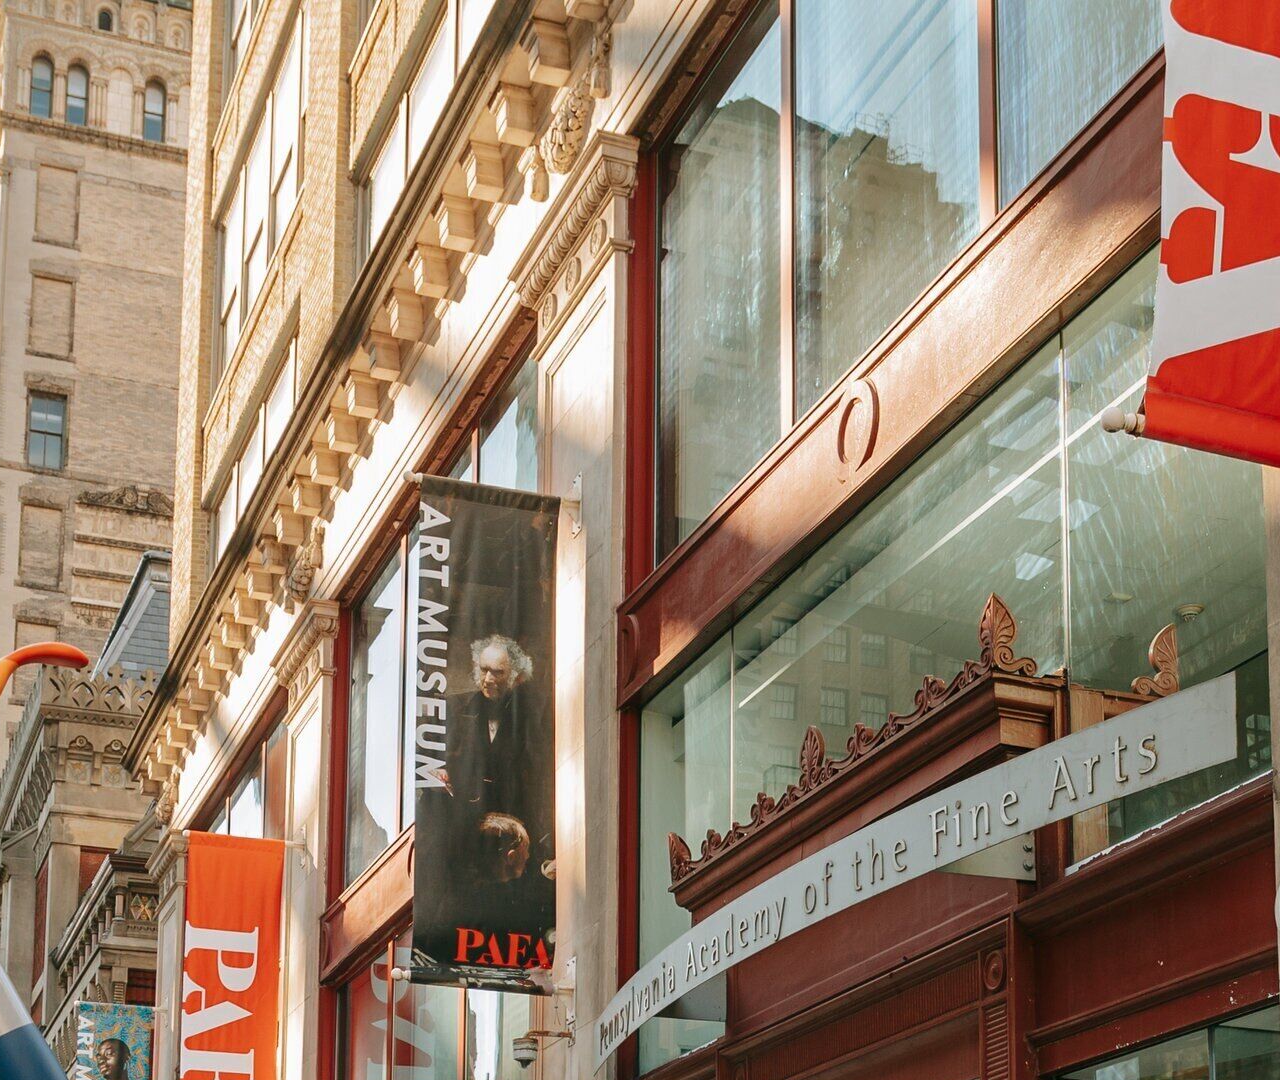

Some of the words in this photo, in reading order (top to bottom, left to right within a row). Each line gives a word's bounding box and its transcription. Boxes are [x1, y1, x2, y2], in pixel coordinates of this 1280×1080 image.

[419, 501, 451, 588] ART
[415, 598, 449, 789] MUSEUM
[599, 962, 676, 1055] Pennsylvania
[686, 895, 788, 981] Academy
[804, 860, 834, 915] of
[850, 837, 908, 892] the
[930, 789, 1020, 857] Fine
[1048, 732, 1159, 810] Arts
[454, 927, 553, 970] PAFA
[77, 1015, 96, 1061] ART
